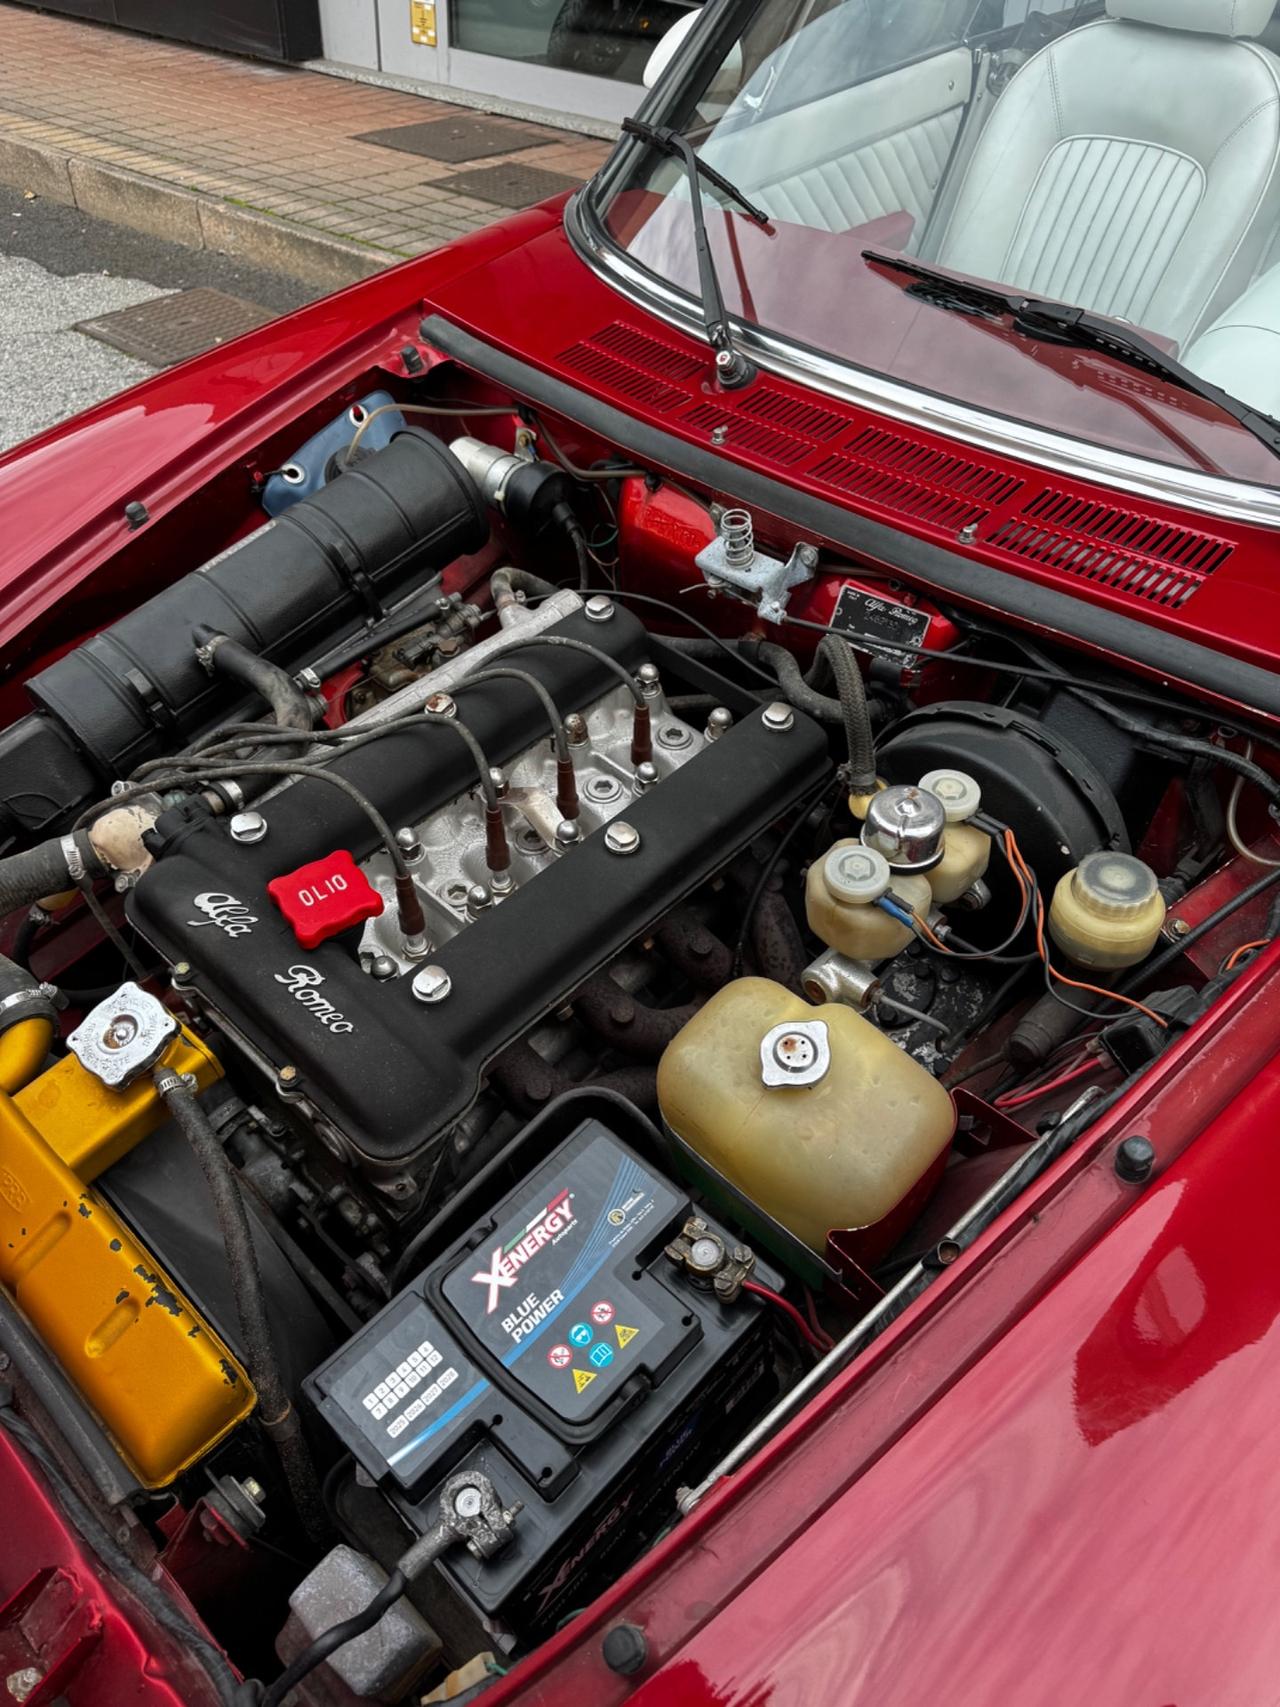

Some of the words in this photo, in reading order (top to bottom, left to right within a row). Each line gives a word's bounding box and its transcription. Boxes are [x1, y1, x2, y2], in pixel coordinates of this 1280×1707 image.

[297, 873, 348, 907] OLIO
[186, 892, 259, 938] Alfa
[273, 964, 354, 1035] Romeo
[501, 1292, 542, 1334] BLUE
[510, 1288, 566, 1344] POWER
